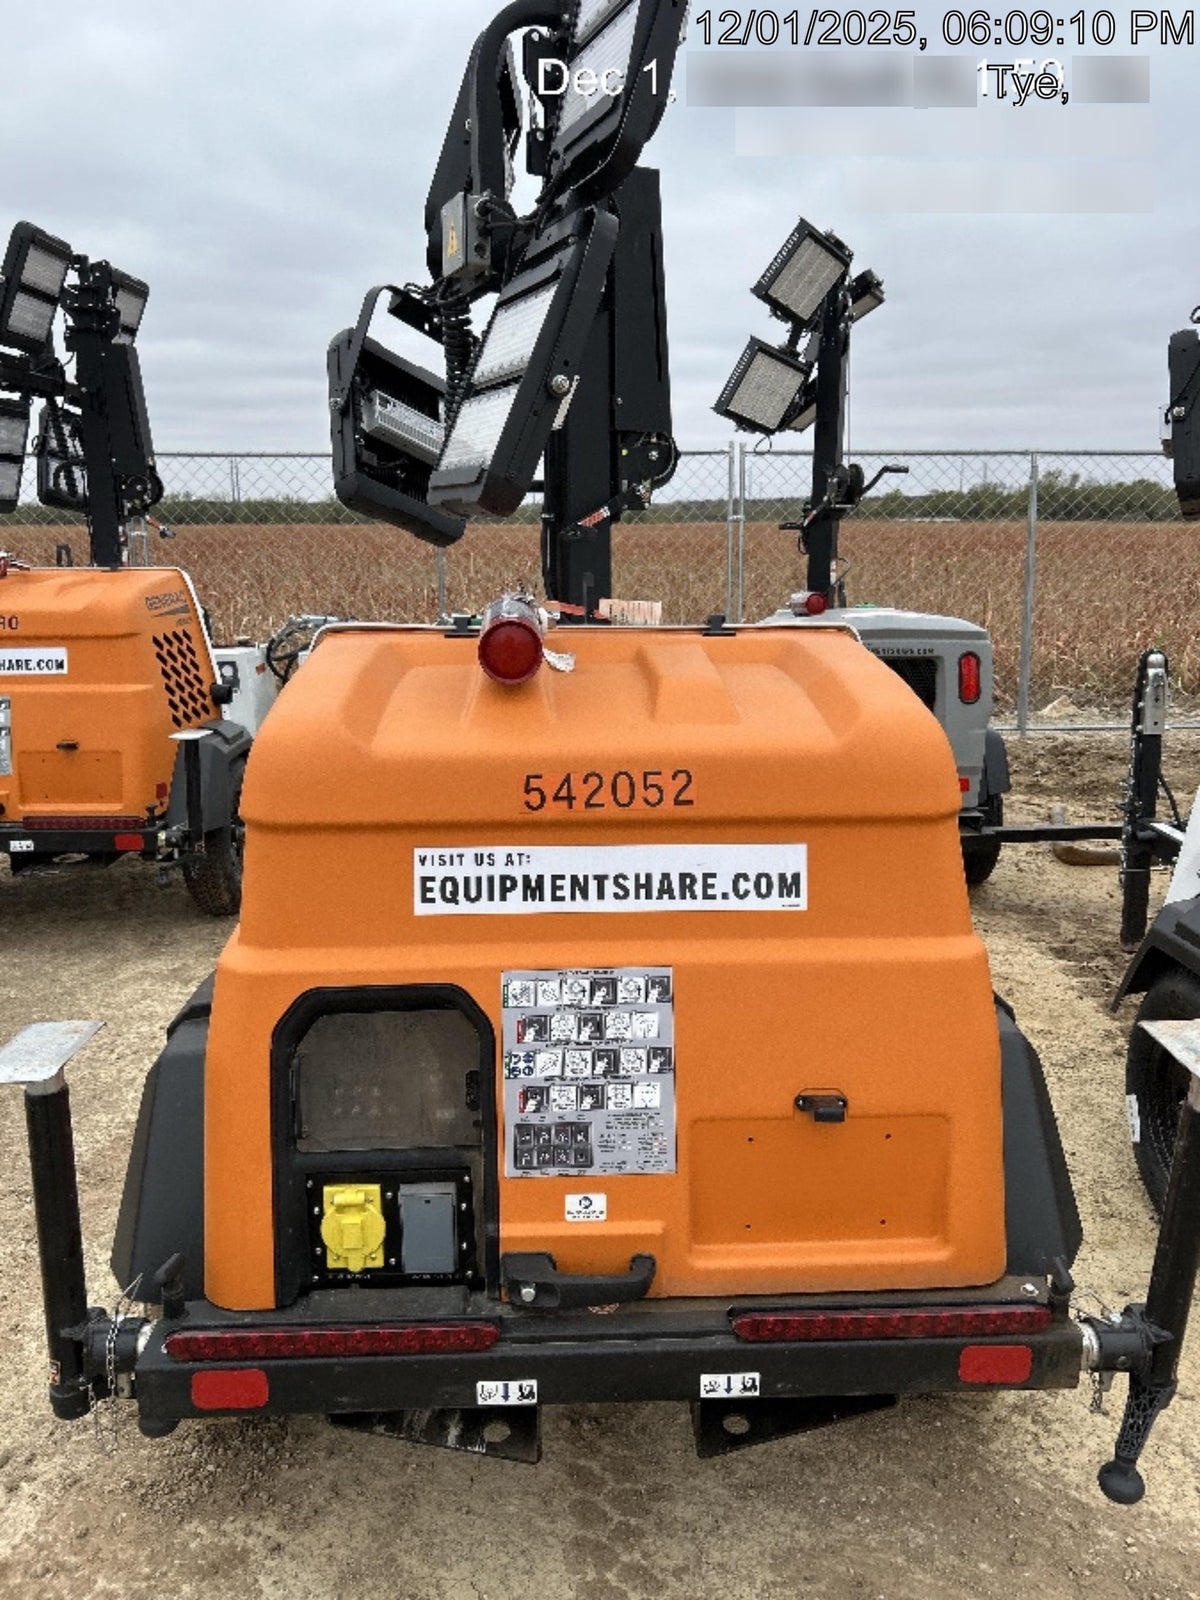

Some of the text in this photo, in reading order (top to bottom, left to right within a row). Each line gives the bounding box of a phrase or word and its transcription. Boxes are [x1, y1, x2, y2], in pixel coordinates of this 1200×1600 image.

[523, 768, 695, 811] 542052
[418, 852, 531, 867] VISIT US AT:
[419, 872, 801, 905] EQUIPMENTSHARE.COM
